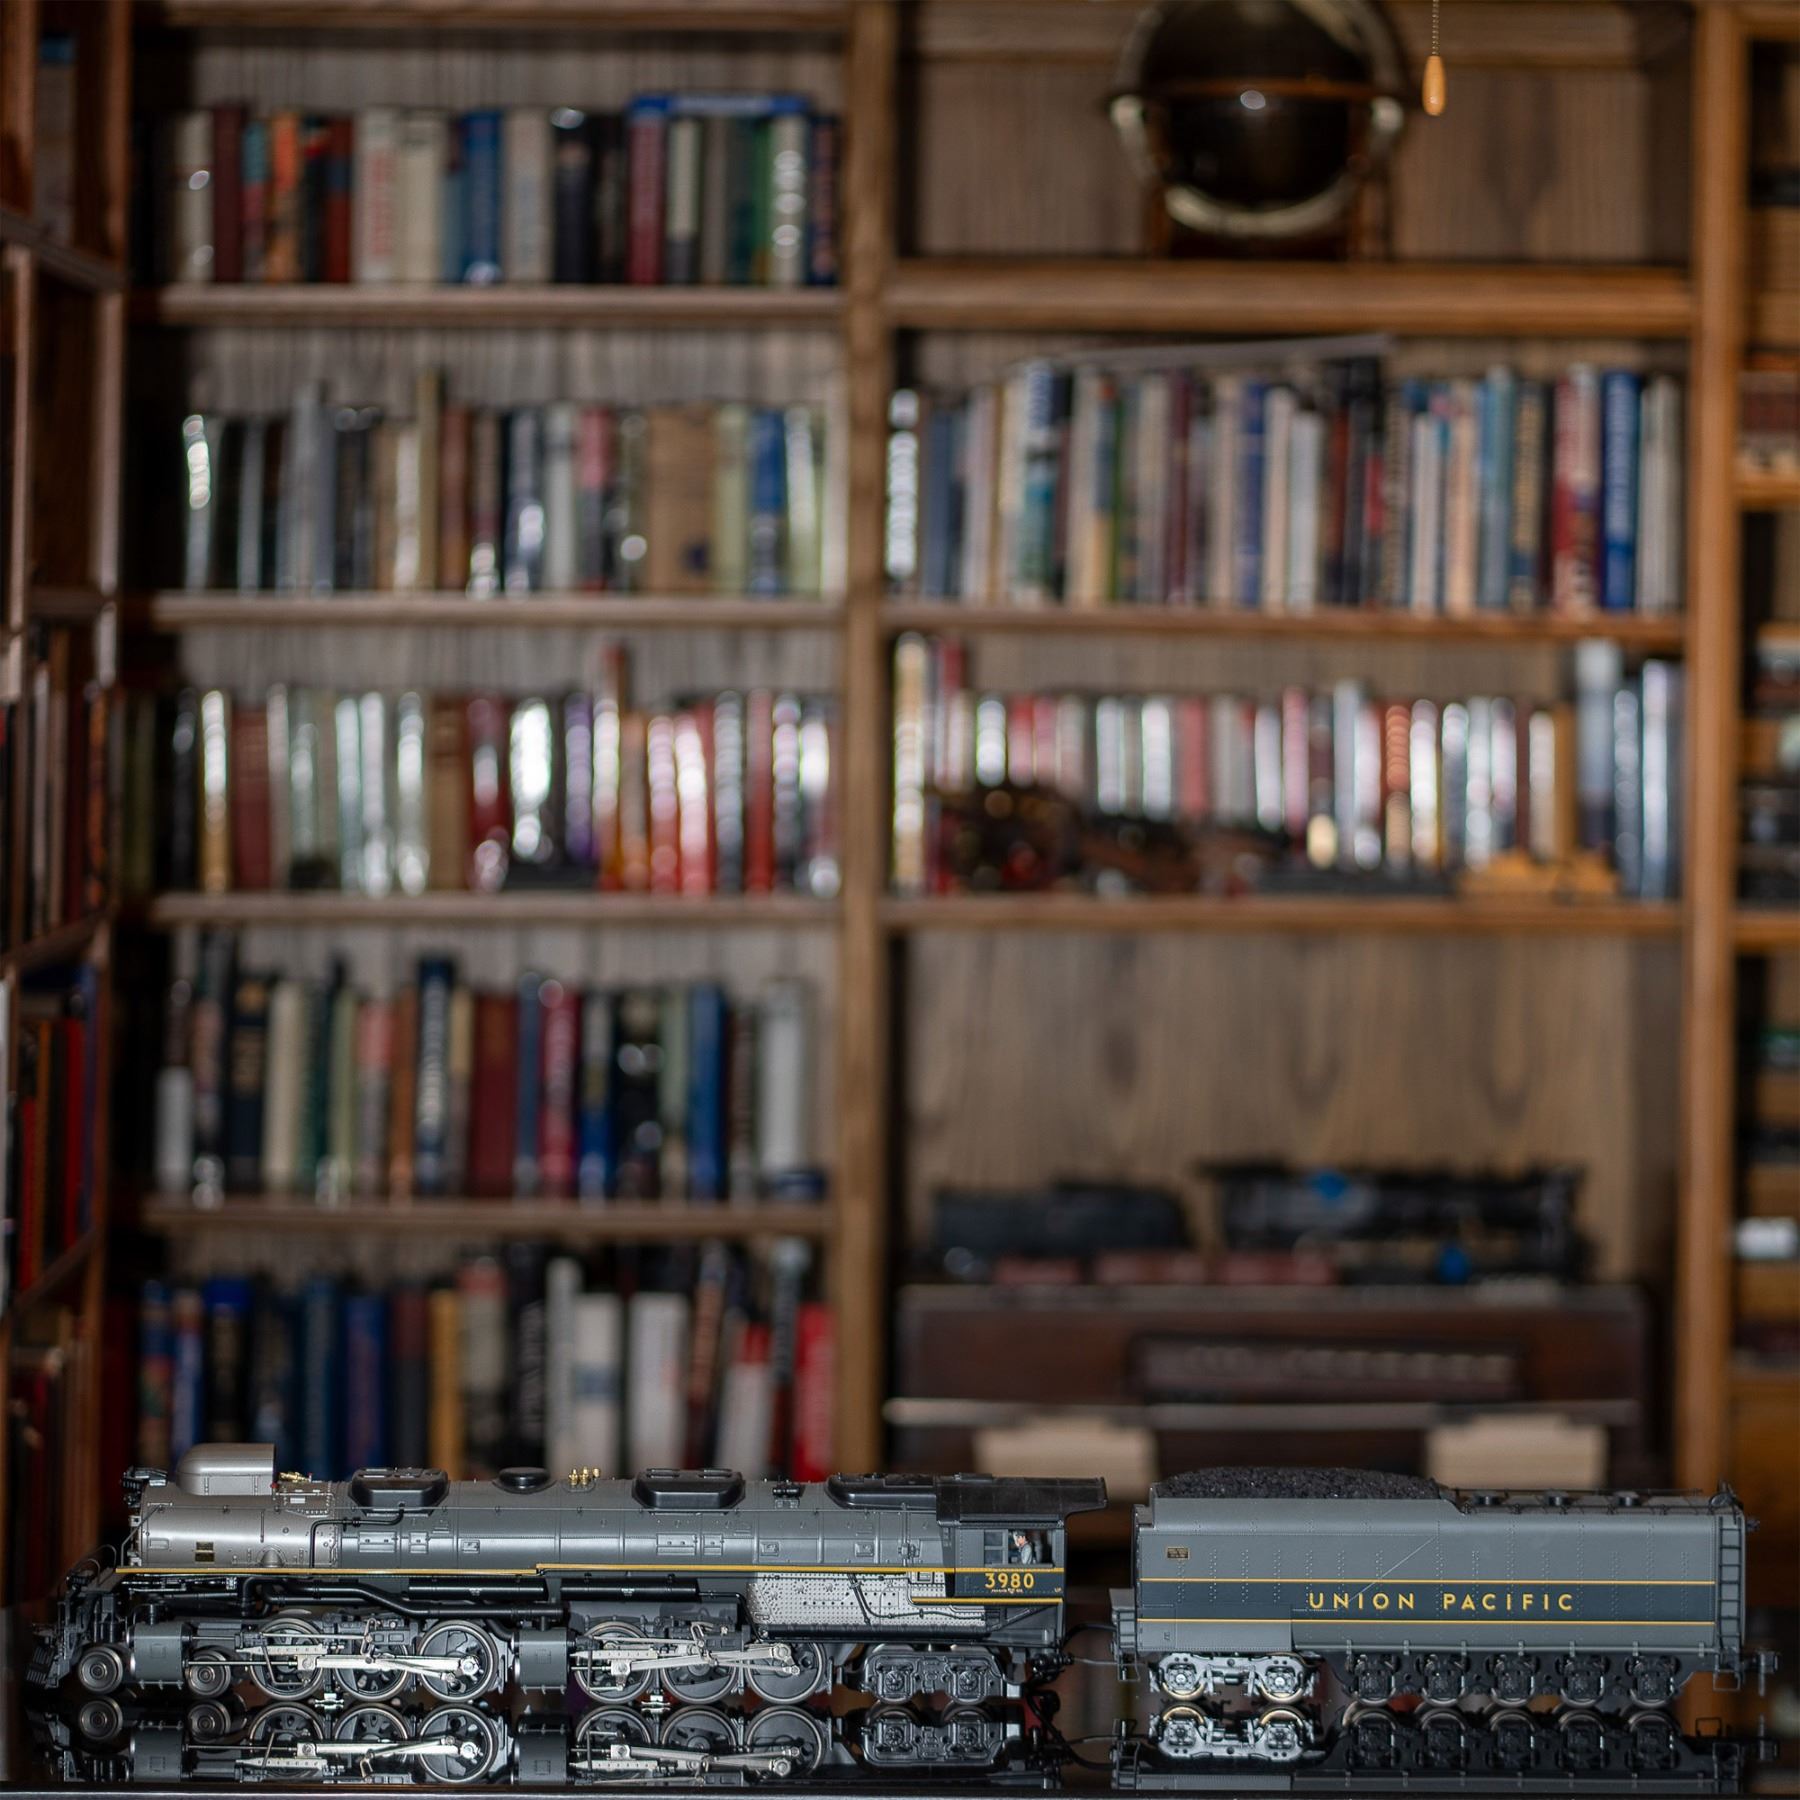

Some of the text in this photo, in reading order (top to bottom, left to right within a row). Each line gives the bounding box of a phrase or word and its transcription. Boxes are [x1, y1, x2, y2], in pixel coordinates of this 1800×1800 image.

[984, 1572, 1035, 1589] 3980
[1309, 1592, 1574, 1611] UNION PACIFIC
